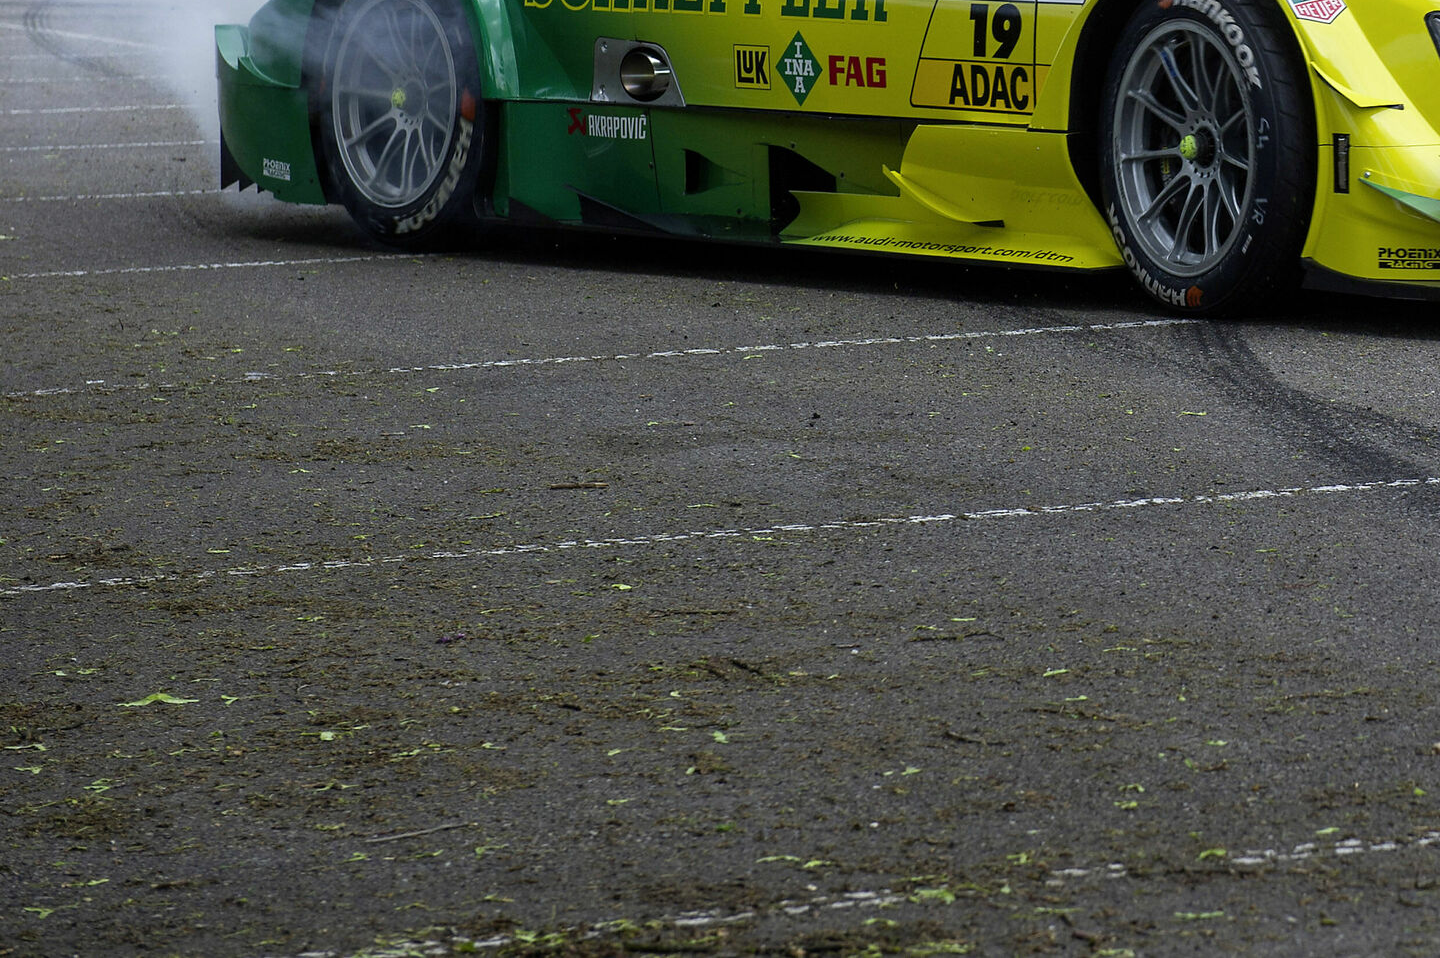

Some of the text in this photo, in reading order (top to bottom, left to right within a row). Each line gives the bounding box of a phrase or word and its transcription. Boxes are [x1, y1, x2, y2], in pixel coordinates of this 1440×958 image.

[1297, 0, 1341, 18] HEUER
[969, 3, 1022, 59] 19
[828, 55, 887, 88] FAG
[949, 63, 1030, 111] ADAC
[812, 235, 1074, 263] www.audi-motorsport.com/dtm
